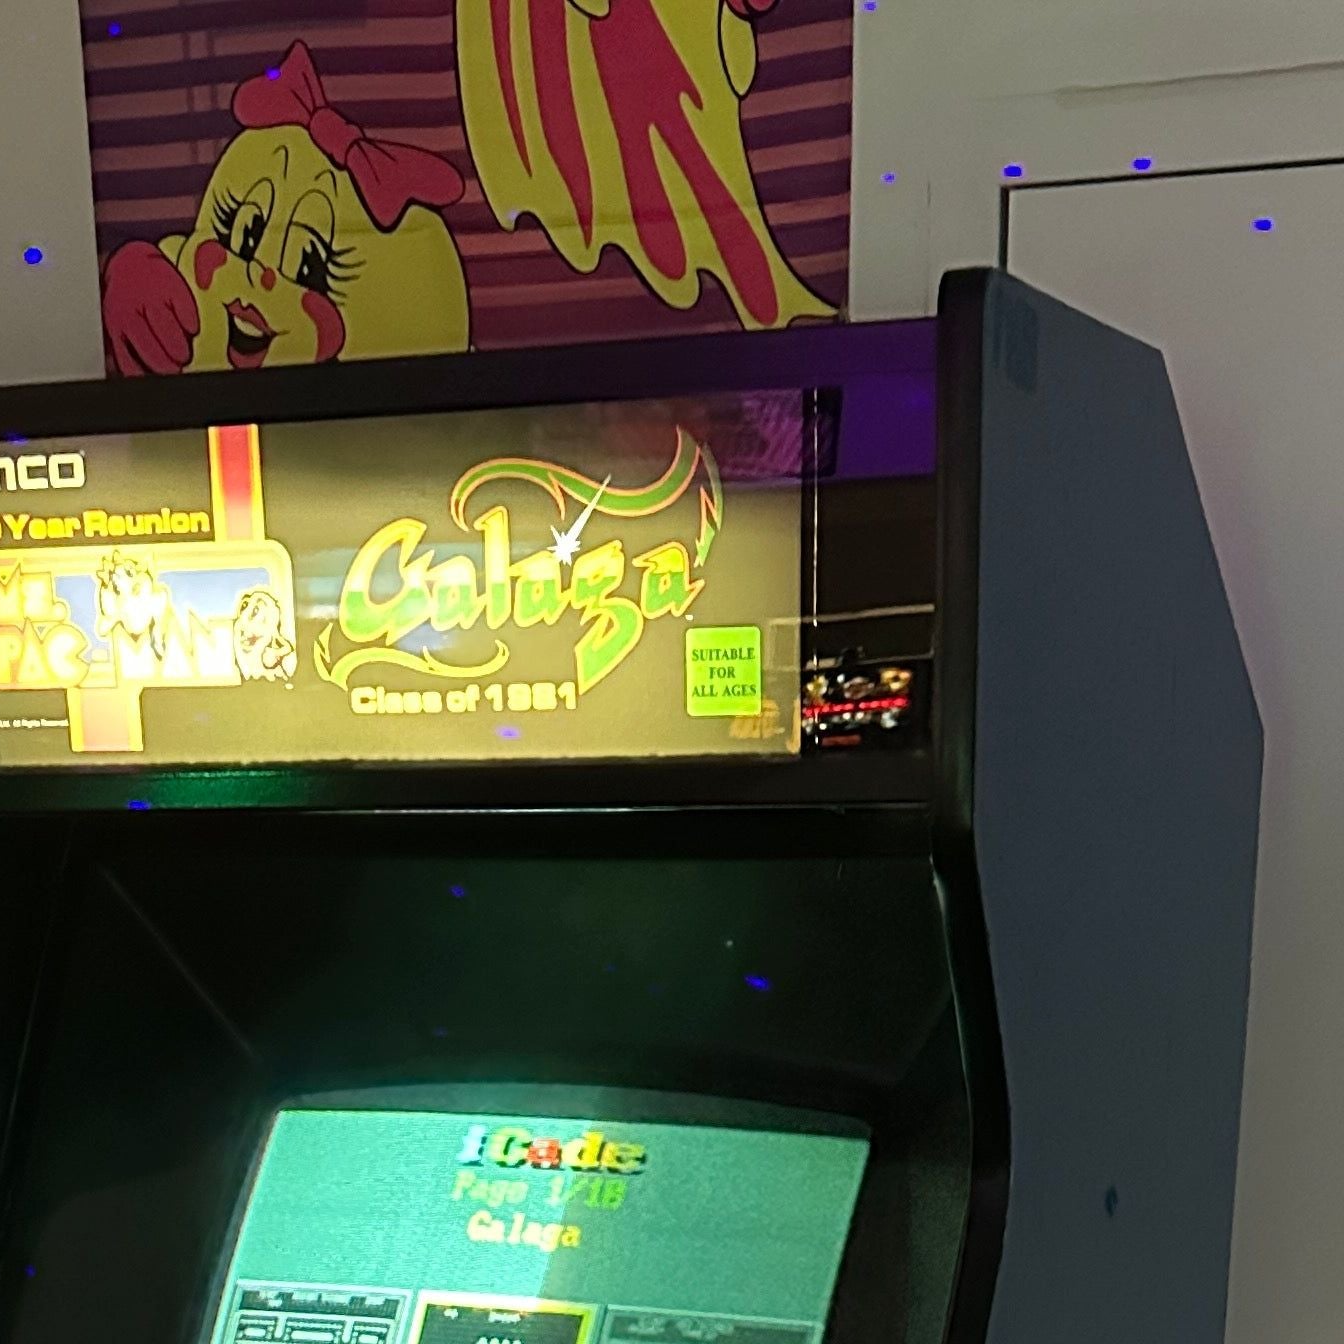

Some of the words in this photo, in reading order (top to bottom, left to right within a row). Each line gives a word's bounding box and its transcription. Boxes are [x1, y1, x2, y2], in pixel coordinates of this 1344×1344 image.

[3, 514, 81, 540] Year
[83, 508, 210, 538] Reunion
[339, 506, 706, 698] Galaga
[691, 647, 756, 660] SUITABLE
[708, 665, 736, 680] FOR
[351, 686, 443, 714] Class
[445, 684, 479, 713] of
[485, 682, 578, 712] 1981
[691, 684, 719, 699] ALL
[722, 685, 757, 699] AGES
[466, 1209, 582, 1253] Galaga
